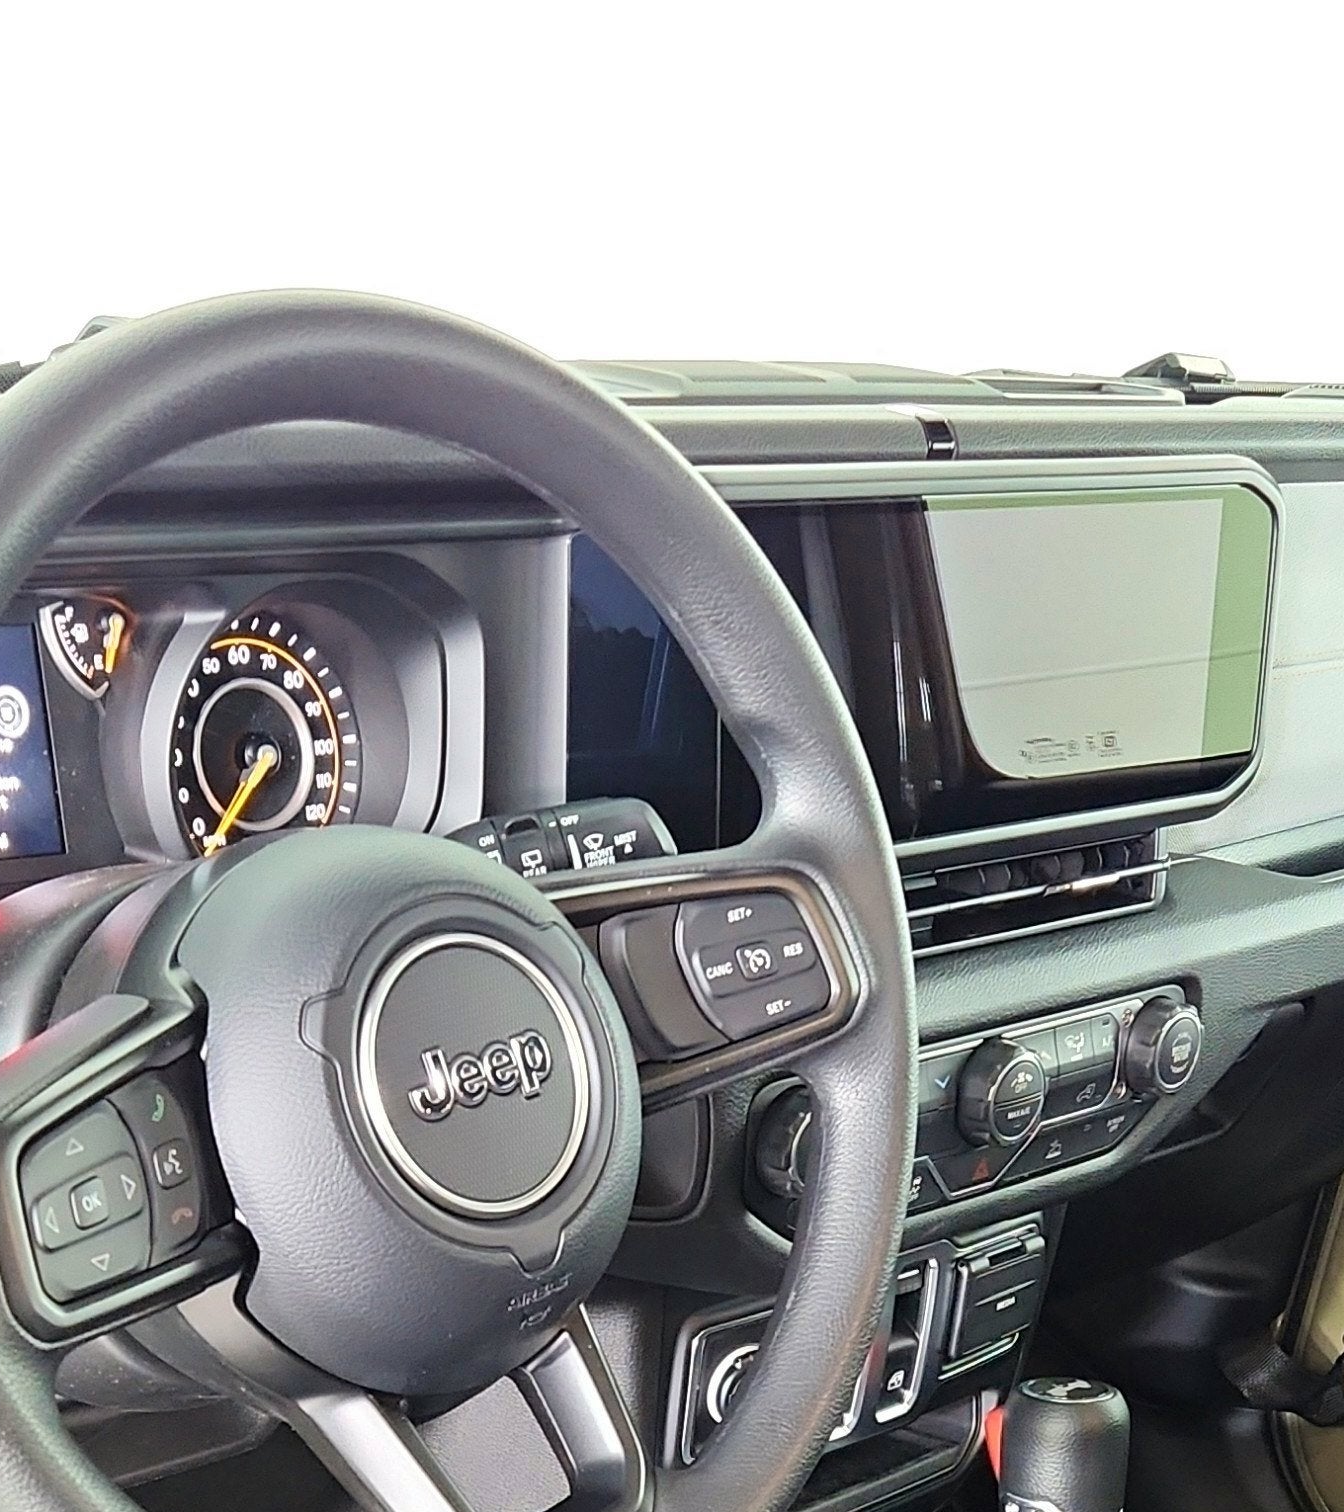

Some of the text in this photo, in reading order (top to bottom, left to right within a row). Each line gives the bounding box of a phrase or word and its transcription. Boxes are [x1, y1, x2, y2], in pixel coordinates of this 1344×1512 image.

[228, 645, 250, 664] 60
[260, 654, 277, 670] 70
[202, 658, 220, 674] 50
[284, 670, 304, 689] 80
[305, 702, 321, 717] 90
[314, 738, 334, 756] 100
[316, 773, 331, 788] 110
[305, 804, 325, 821] 120
[560, 814, 580, 826] OFF
[193, 817, 206, 836] 0
[478, 835, 495, 847] ON
[613, 831, 637, 846] MIST
[584, 846, 614, 862] FRONT
[783, 942, 804, 958] RES
[706, 961, 734, 980] CANC
[407, 1029, 552, 1121] Jeep
[81, 1192, 102, 1211] OK
